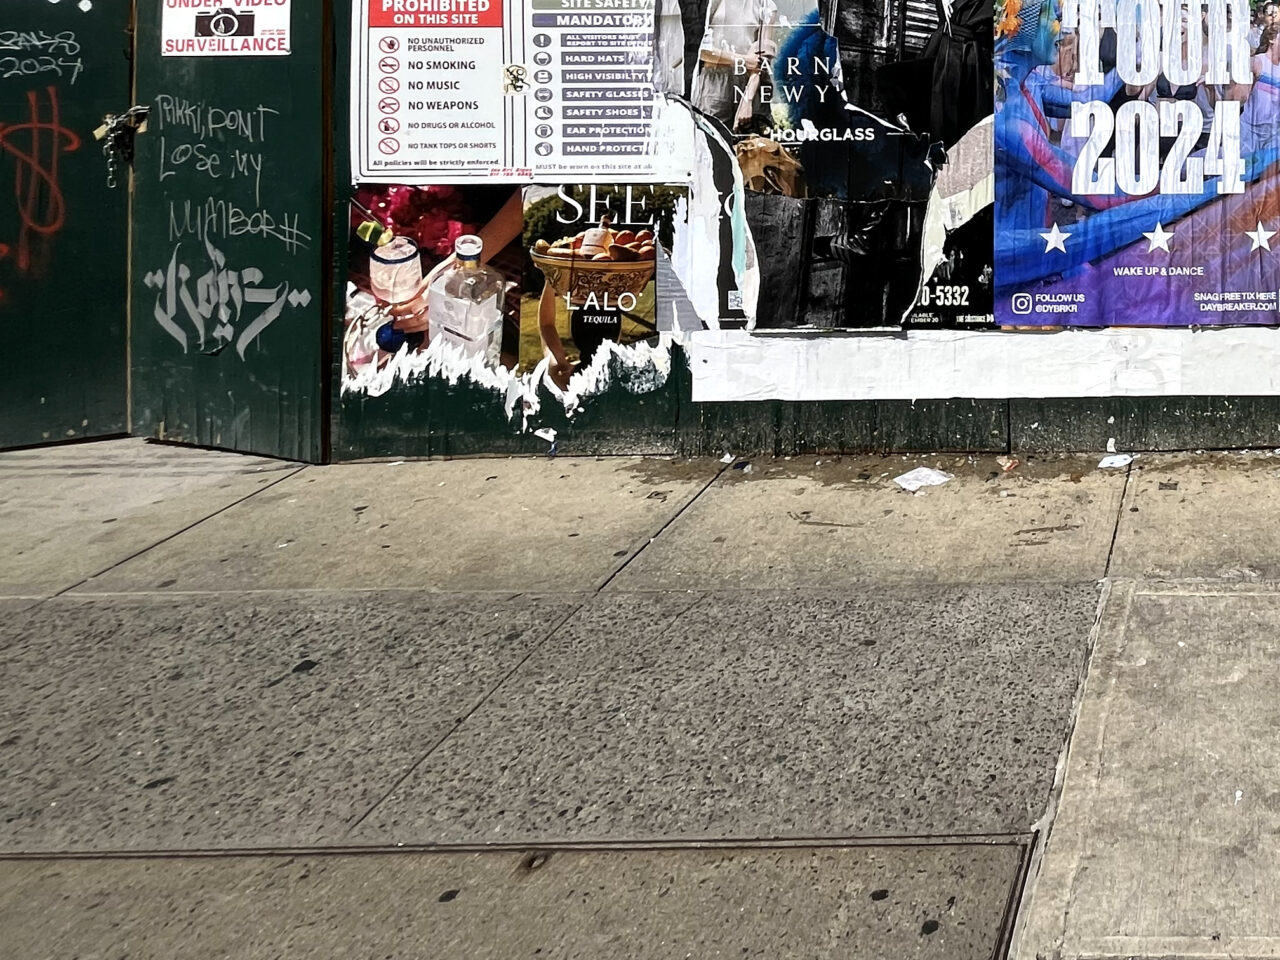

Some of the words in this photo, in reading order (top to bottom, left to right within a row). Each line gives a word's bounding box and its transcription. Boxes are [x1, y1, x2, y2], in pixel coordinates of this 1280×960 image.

[393, 14, 414, 24] ON
[418, 14, 448, 24] THIS
[451, 14, 478, 24] SITE
[166, 37, 286, 52] SURVEILLANCE
[408, 61, 423, 70] NO
[426, 61, 476, 70] SMOKING
[408, 81, 423, 90] NO
[426, 81, 460, 90] MUSIC
[408, 101, 424, 110] NO
[426, 101, 479, 110] WEAPONS
[770, 128, 875, 141] HOURGLASS
[1071, 100, 1246, 194] 2024
[556, 184, 653, 225] SEE
[1113, 267, 1143, 276] WAKE
[1145, 267, 1159, 276] UP
[1160, 267, 1167, 276] &
[1169, 267, 1204, 276] DANCE
[917, 285, 969, 306] 0-5332
[1035, 294, 1072, 302] FOLLOW
[1073, 294, 1085, 302] US
[1194, 292, 1219, 301] SNAG
[1220, 292, 1240, 301] FREE
[1241, 292, 1255, 300] TIX
[1256, 292, 1276, 300] HERE
[564, 291, 637, 311] LALO
[1035, 304, 1078, 313] @DYBRKR
[1200, 302, 1277, 311] DAYBREAKER.COM
